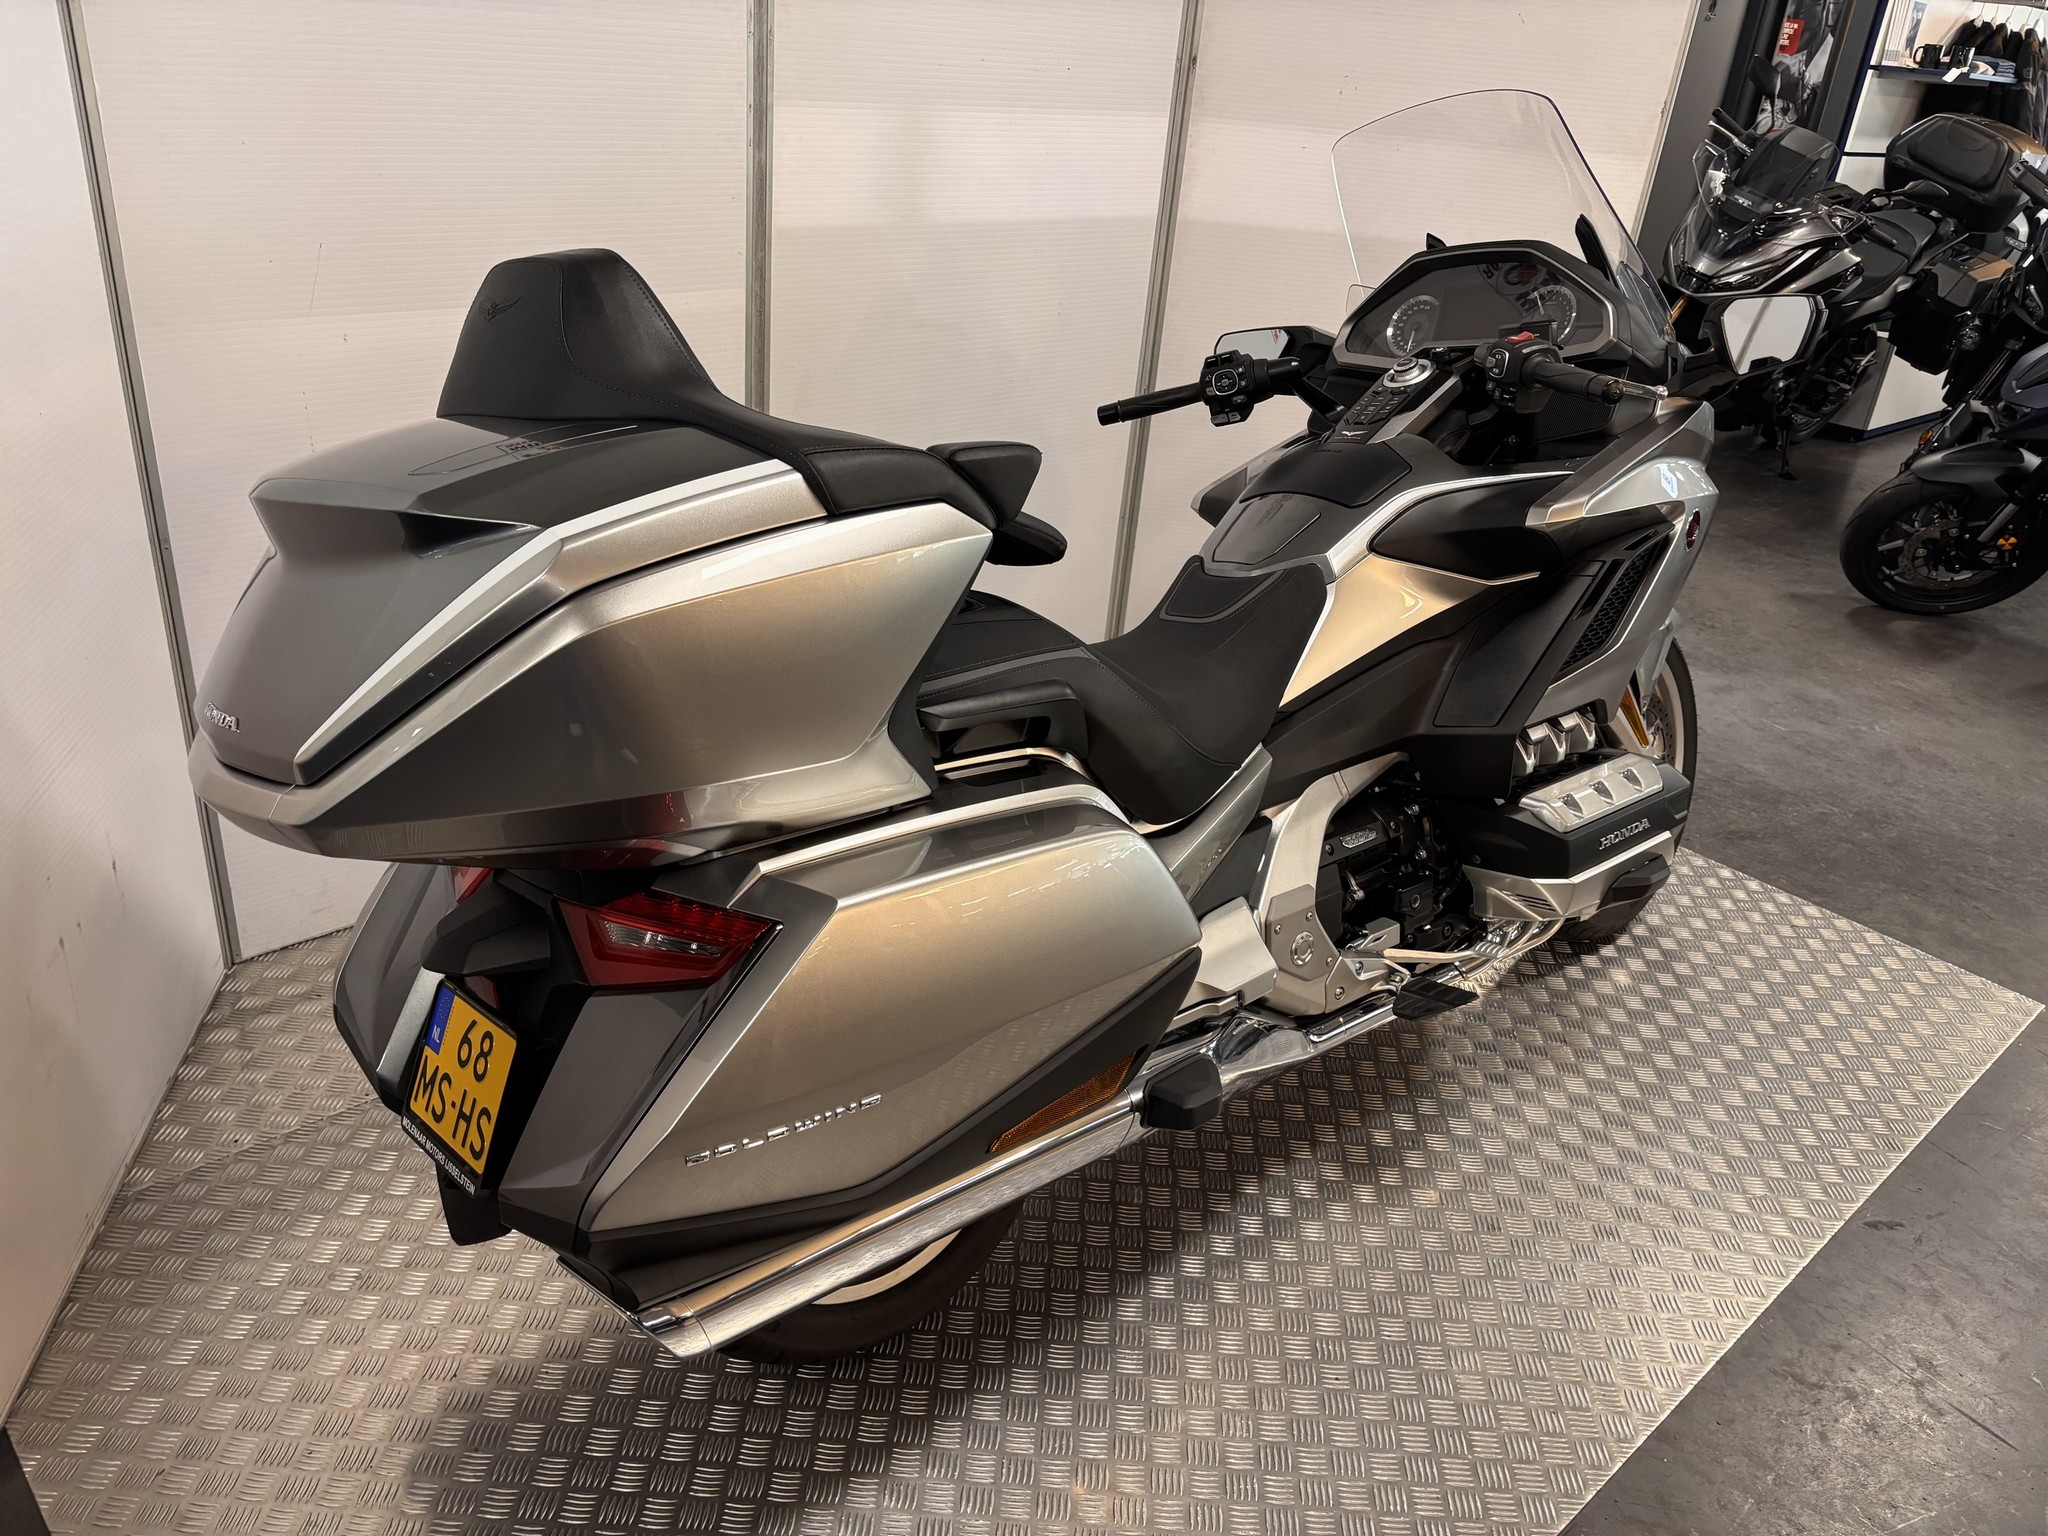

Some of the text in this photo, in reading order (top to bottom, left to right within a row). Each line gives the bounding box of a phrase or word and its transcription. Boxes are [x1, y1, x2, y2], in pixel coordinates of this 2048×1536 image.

[1600, 819, 1650, 850] HONDA
[432, 1025, 441, 1044] NL
[457, 1019, 494, 1082] 68
[413, 1055, 492, 1161] MS-HS
[685, 1093, 882, 1167] GOLDWING
[402, 1116, 426, 1146] MOLENAAR
[425, 1140, 446, 1165] MOTORS
